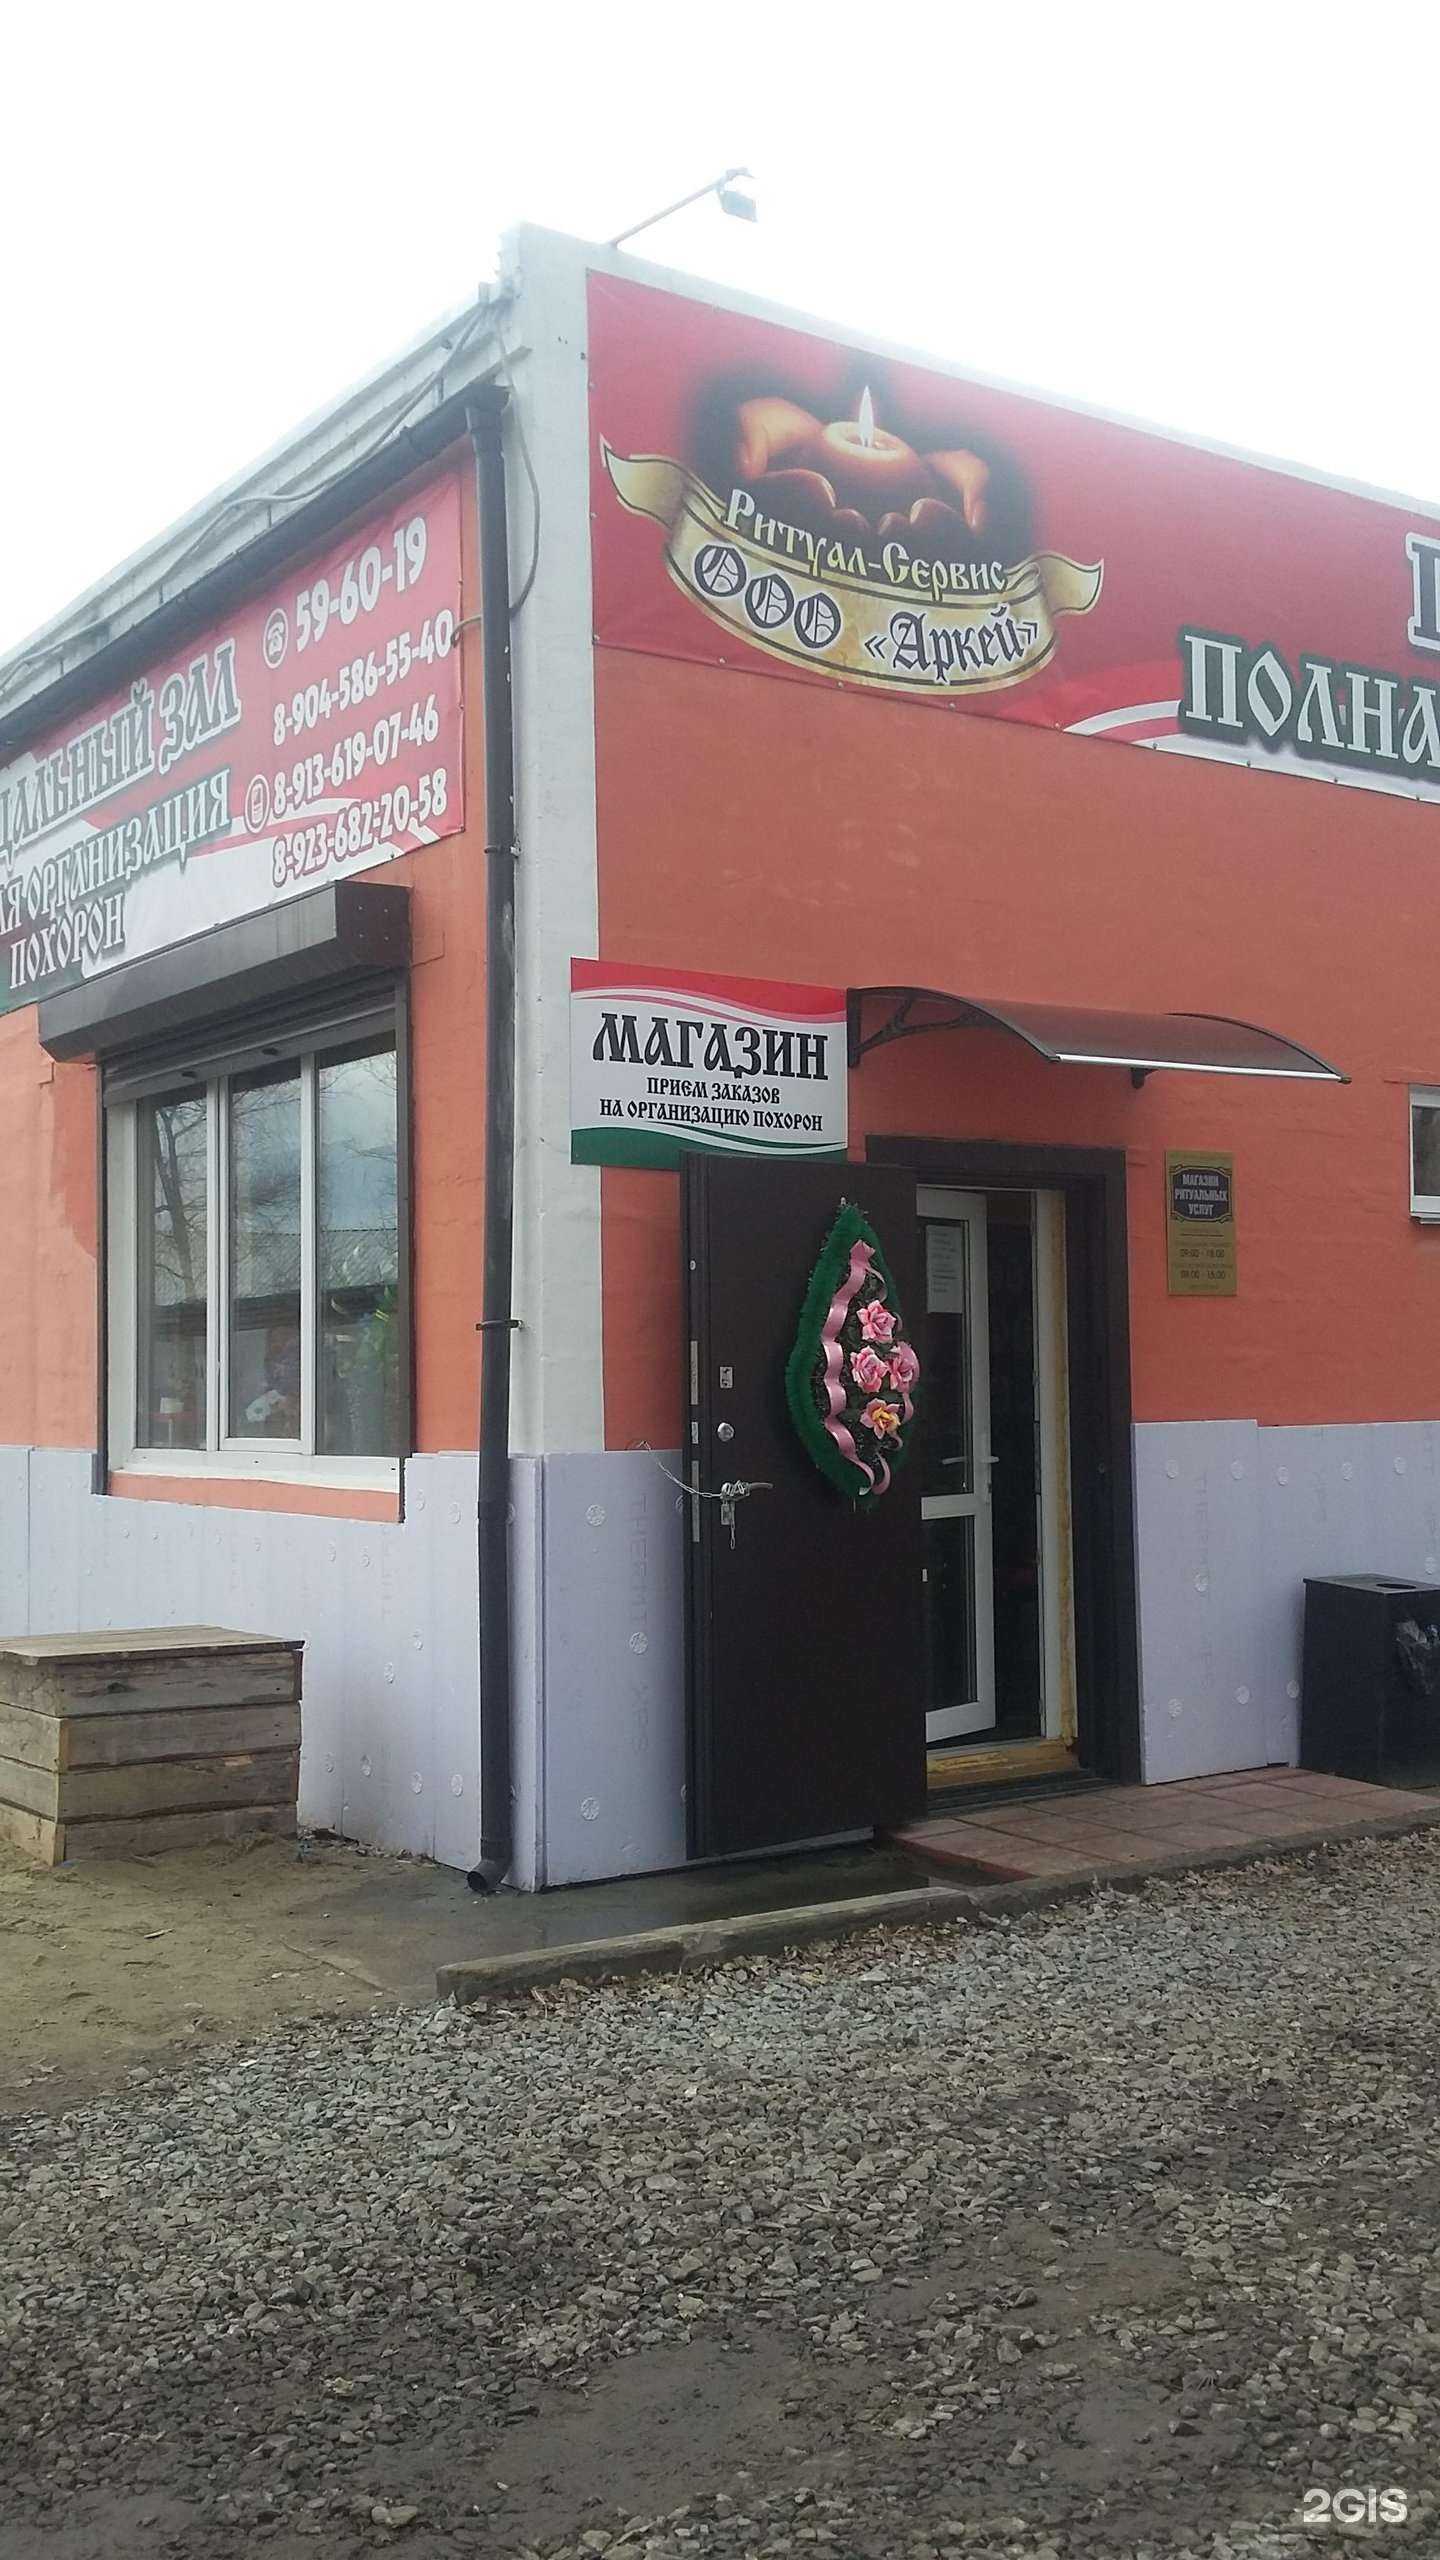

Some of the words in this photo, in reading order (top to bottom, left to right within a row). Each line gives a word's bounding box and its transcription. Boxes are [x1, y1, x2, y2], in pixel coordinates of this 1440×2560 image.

[296, 516, 427, 652] 59-60-19
[723, 488, 1008, 601] Ритуал-Сервис
[694, 544, 842, 648] ООО
[864, 606, 1038, 683] «Аркей»
[274, 609, 453, 746] 8-904-586-55-40
[0, 679, 154, 870] АЛЬНЫЙ
[160, 645, 241, 772] ЗАЛ
[273, 694, 438, 814] 8-913-619-07-46
[26, 768, 230, 920] ОРГАНИЗАЦИЯ
[273, 767, 447, 884] 8-923-682-20-58
[9, 893, 125, 989] ПОХОРОН
[592, 1012, 829, 1080] МАГАЗИН
[646, 1076, 708, 1099] ПРИЕМ
[711, 1082, 780, 1105] ЗАКАЗОВ
[599, 1098, 625, 1117] НА
[627, 1101, 750, 1128] ОРГАНИЗАЦИЮ
[752, 1110, 823, 1132] ПОХОРОН
[1174, 1187, 1228, 1202] РИТУАЛЬНЫХ
[1182, 1173, 1219, 1187] МАГАЗИН
[1187, 1202, 1215, 1216] УСЛУГ
